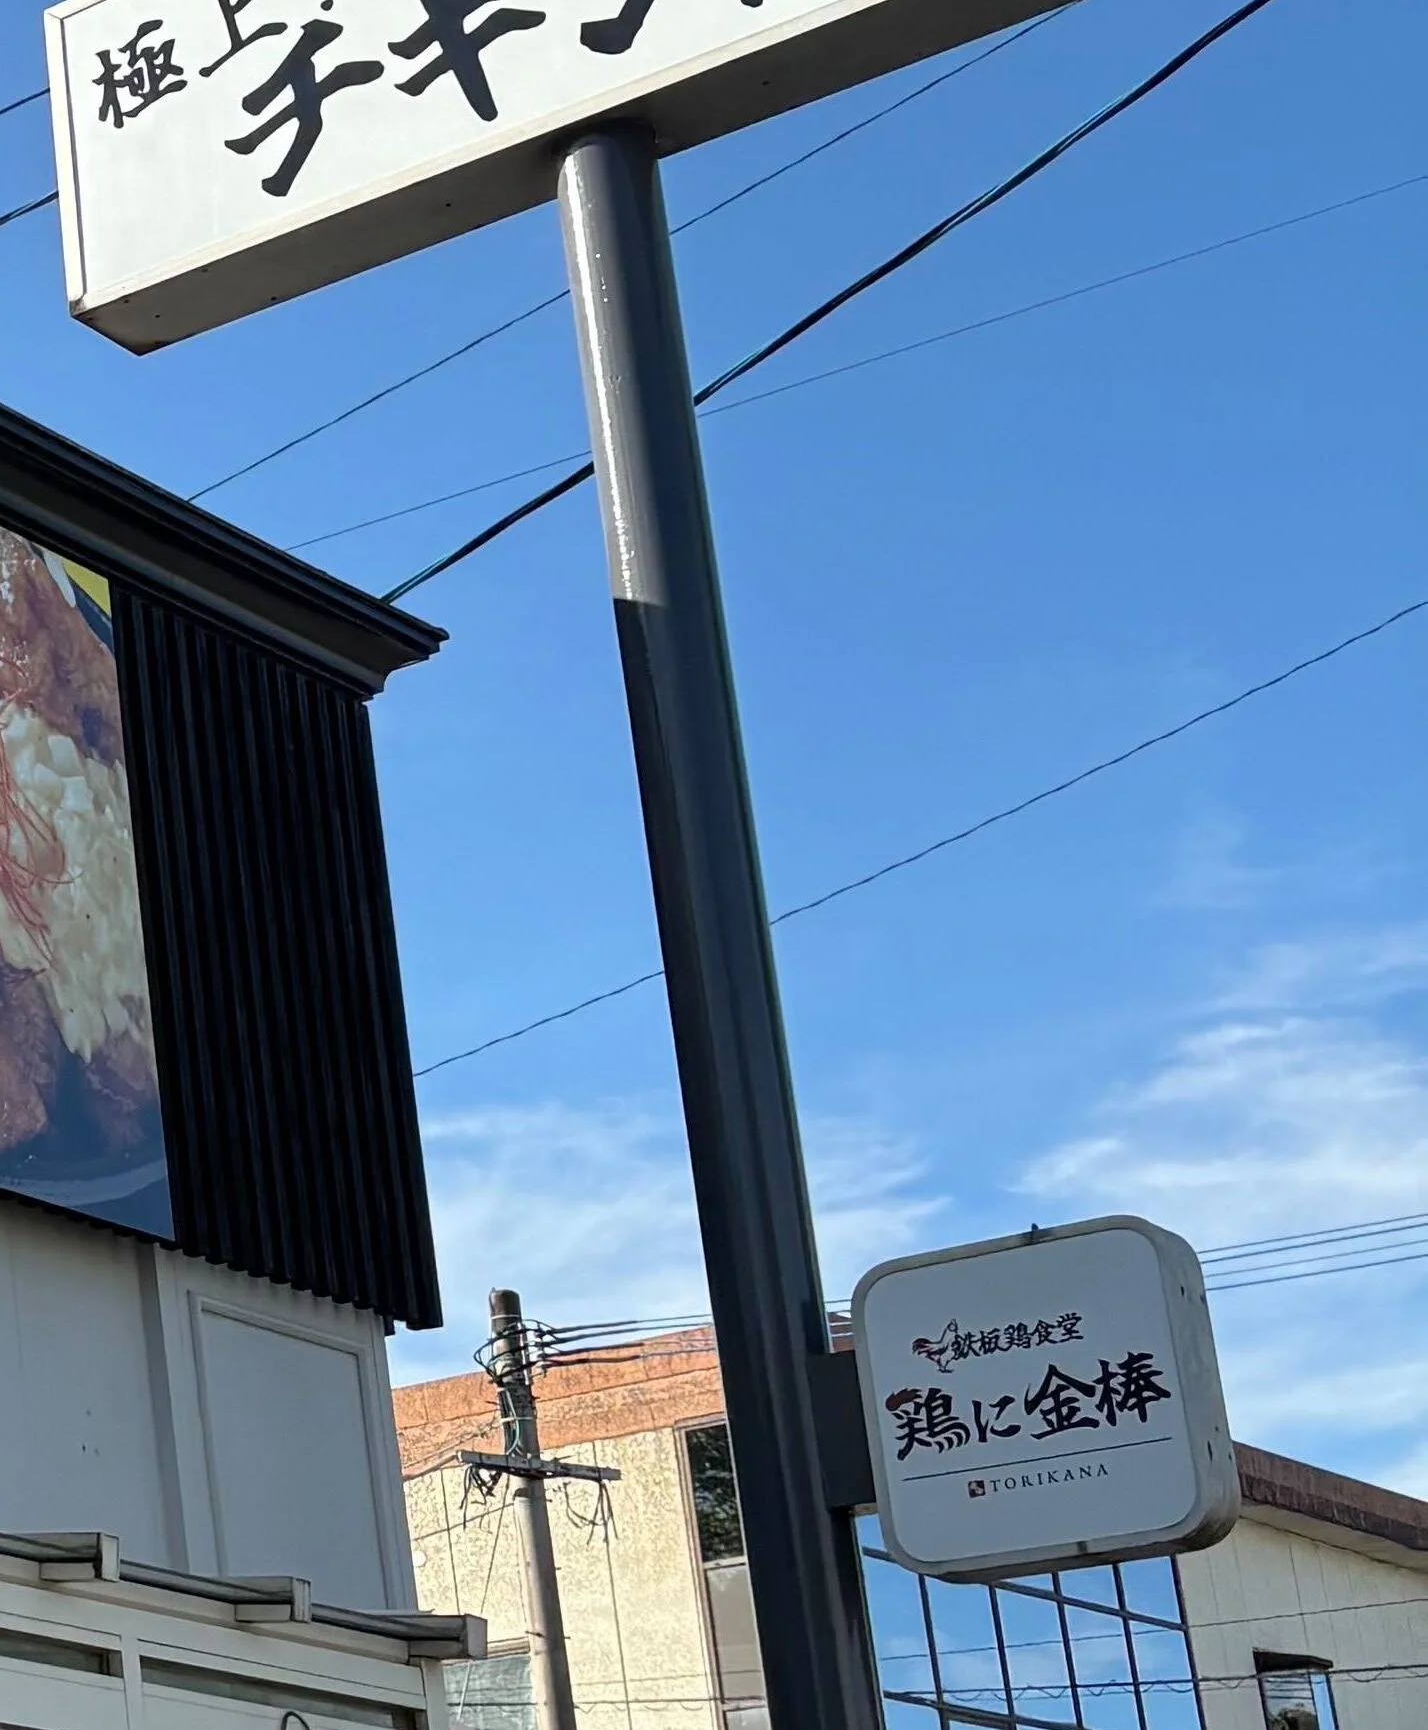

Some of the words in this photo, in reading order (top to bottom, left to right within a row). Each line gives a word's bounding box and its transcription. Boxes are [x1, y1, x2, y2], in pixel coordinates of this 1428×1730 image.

[885, 1351, 1172, 1461] 鶏に金棒
[990, 1463, 1109, 1492] TORIKANA
